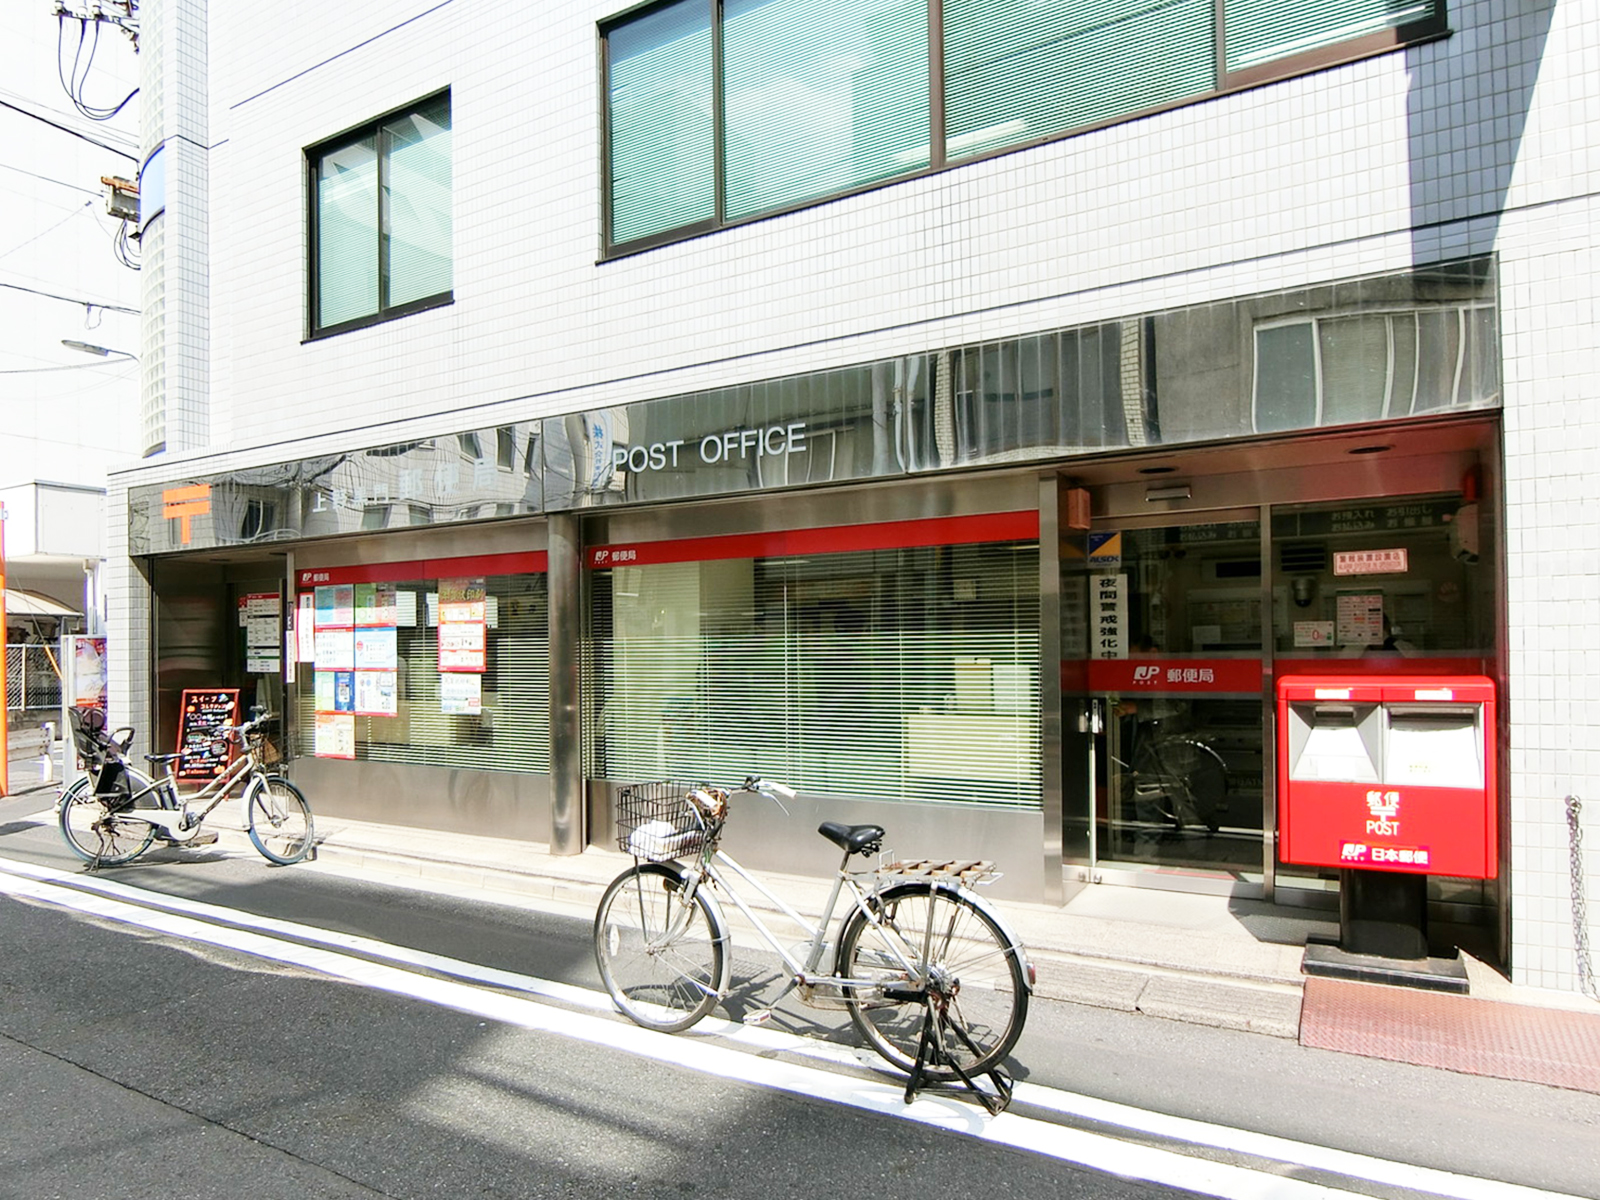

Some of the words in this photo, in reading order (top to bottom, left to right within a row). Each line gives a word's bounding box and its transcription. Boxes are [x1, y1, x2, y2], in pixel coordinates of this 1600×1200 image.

[613, 440, 685, 473] POST
[700, 423, 807, 464] OFFICE
[1099, 578, 1118, 659] 夜間警戒強化中
[1134, 666, 1160, 680] JP
[1167, 668, 1214, 683] 郵便局
[1366, 790, 1400, 809] 郵便
[1366, 820, 1400, 836] POST
[1342, 843, 1367, 857] JP
[1371, 847, 1428, 865] 日本郵便
